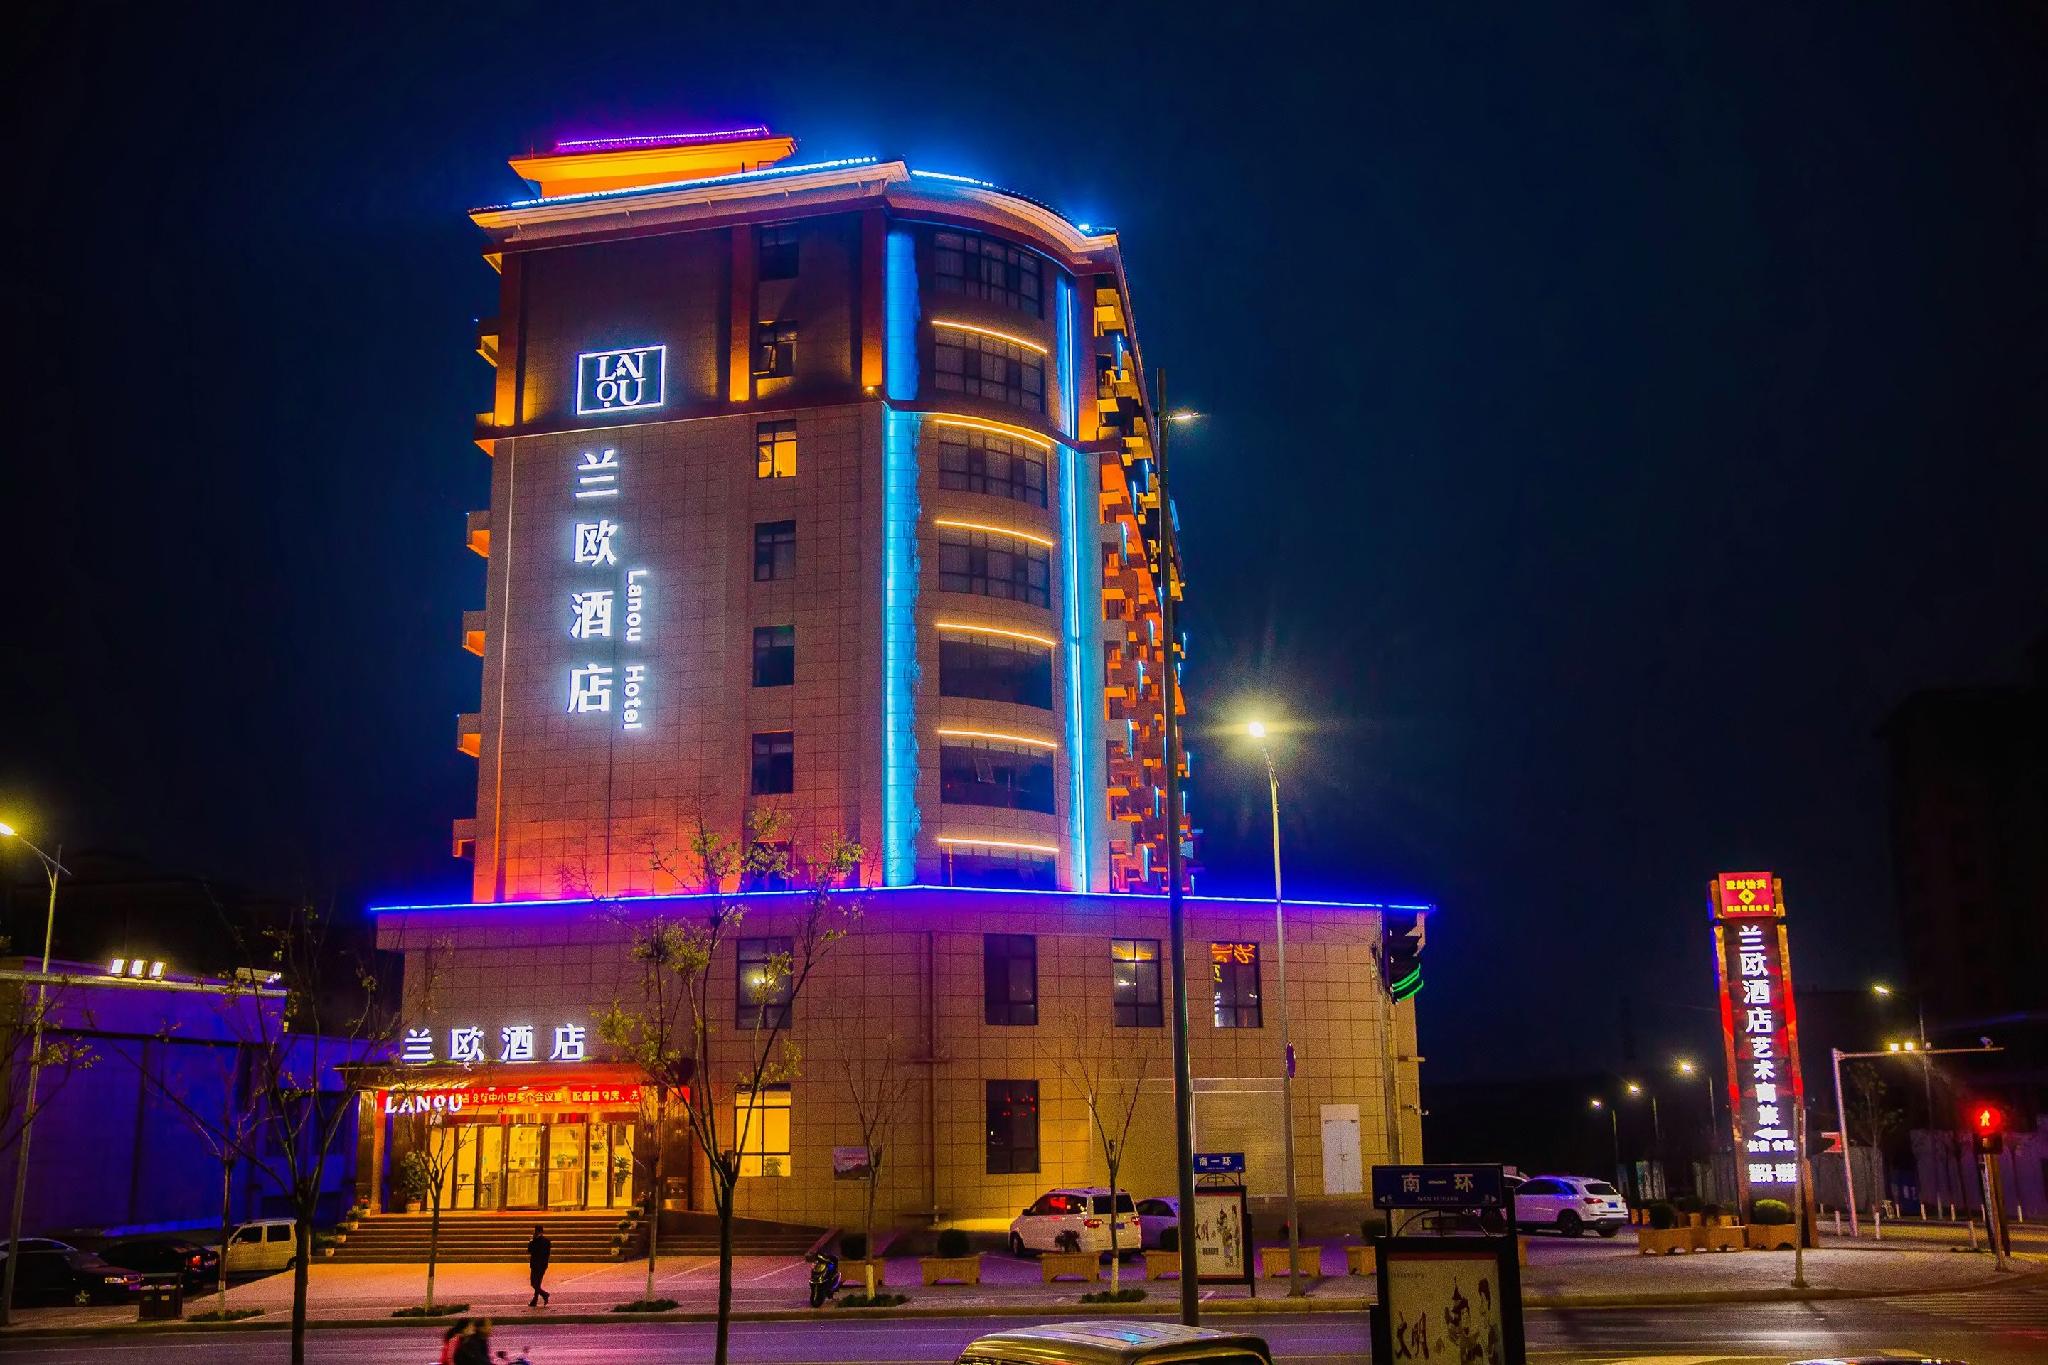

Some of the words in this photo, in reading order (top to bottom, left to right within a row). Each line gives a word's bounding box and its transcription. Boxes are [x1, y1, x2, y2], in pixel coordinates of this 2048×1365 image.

[567, 448, 619, 714] 兰欧酒店
[625, 569, 648, 643] Lanou
[623, 664, 645, 730] Hotel
[401, 1022, 586, 1063] 兰欧酒店
[1199, 1156, 1232, 1167] 南一环
[1400, 1172, 1475, 1193] 南一环
